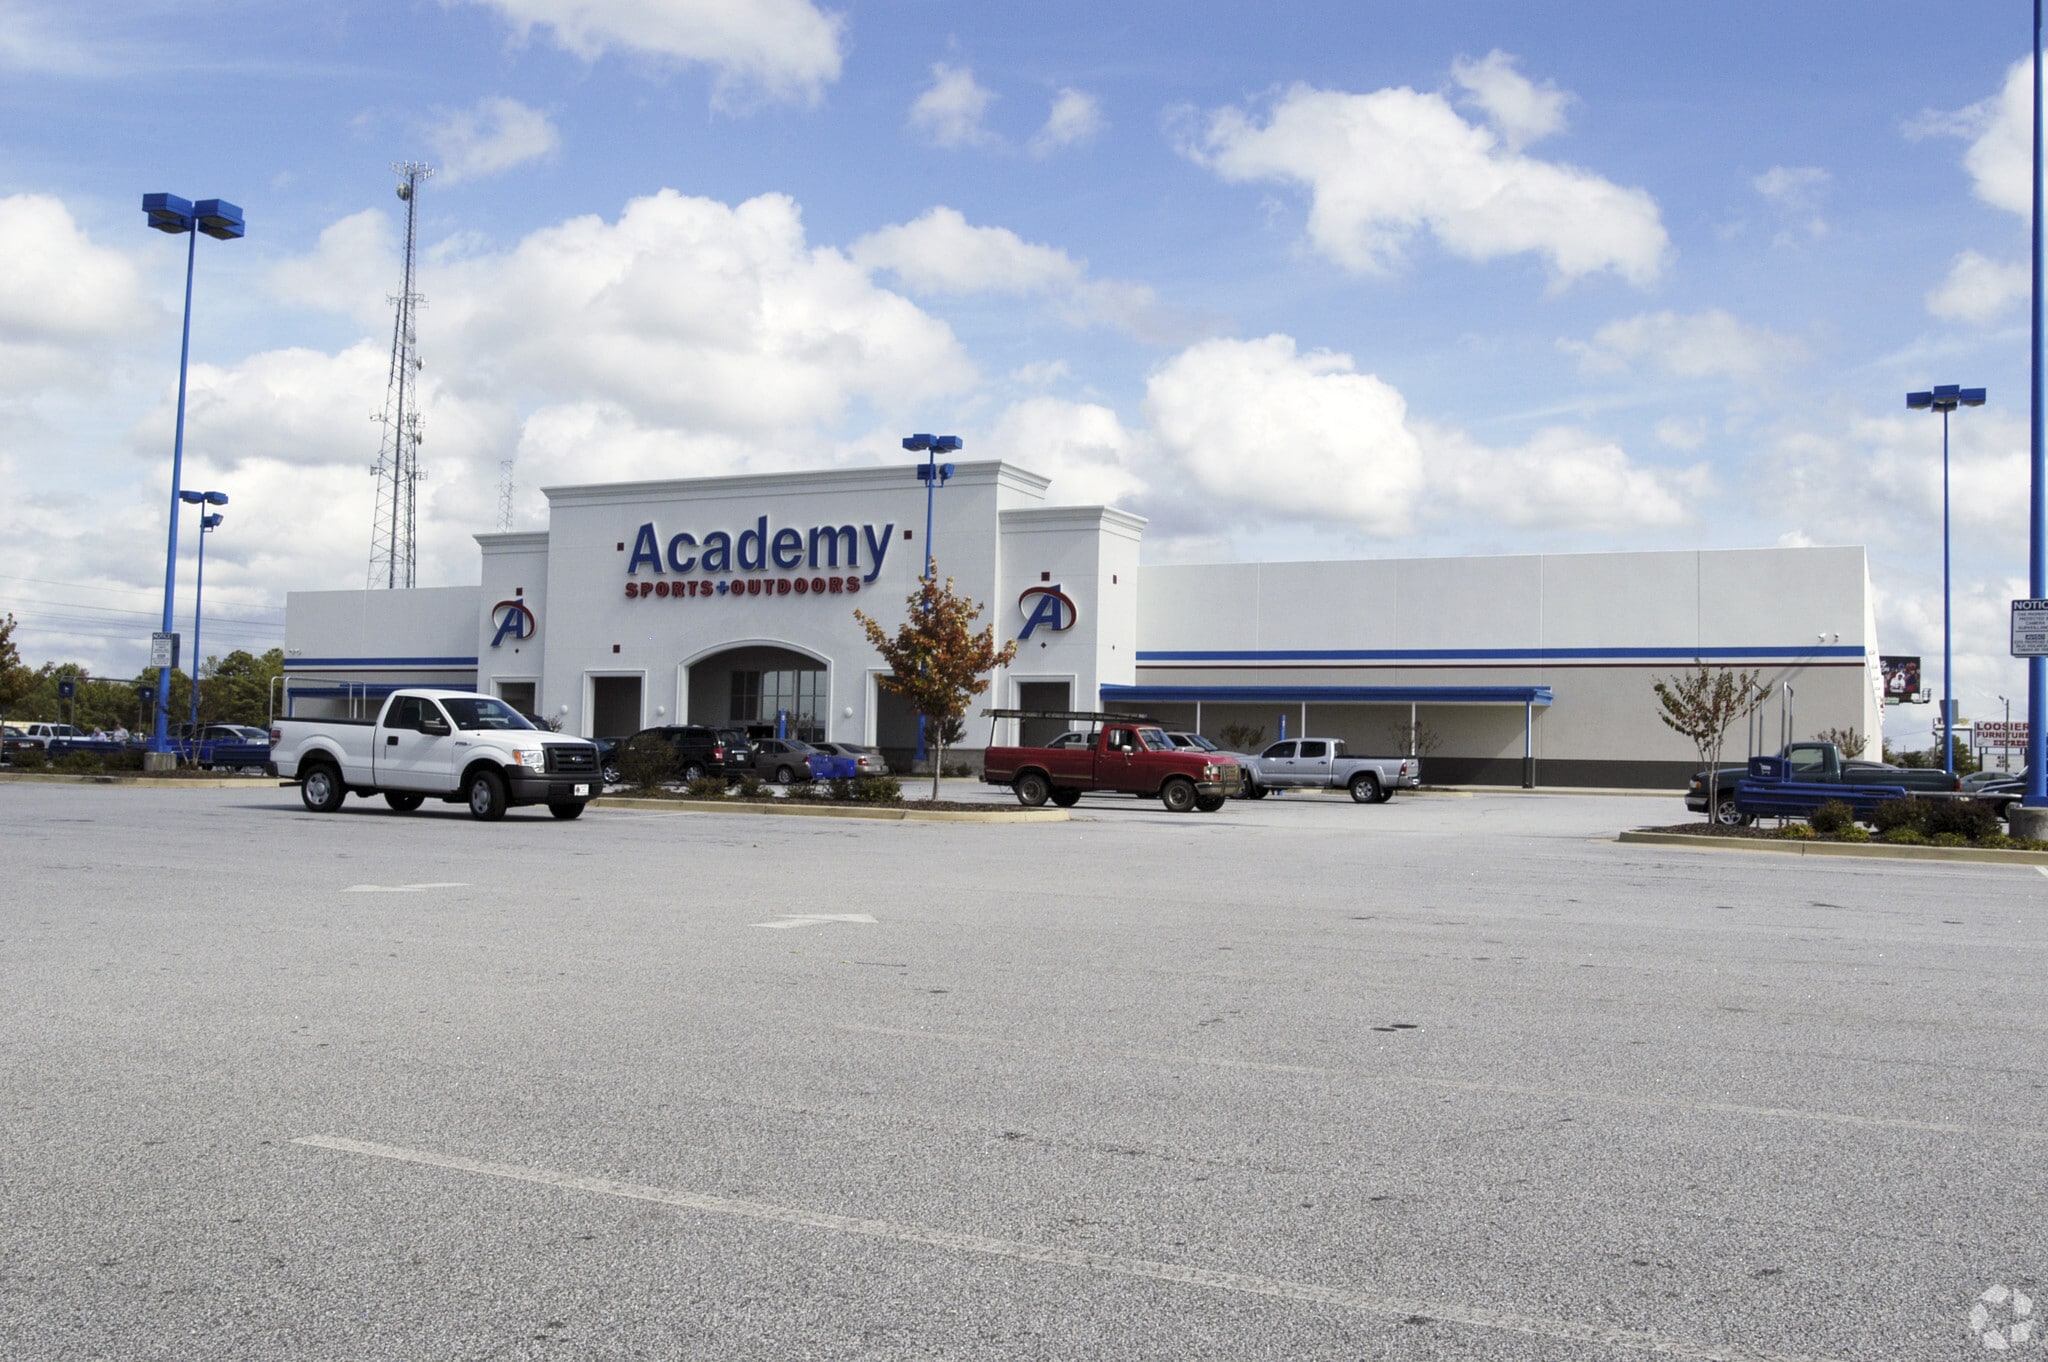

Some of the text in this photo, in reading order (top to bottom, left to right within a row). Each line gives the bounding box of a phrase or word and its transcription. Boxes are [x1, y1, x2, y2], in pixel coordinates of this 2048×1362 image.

[627, 515, 894, 583] Academy
[1976, 722, 2029, 731] LOOSIER
[1976, 731, 2029, 739] FURNIUR
